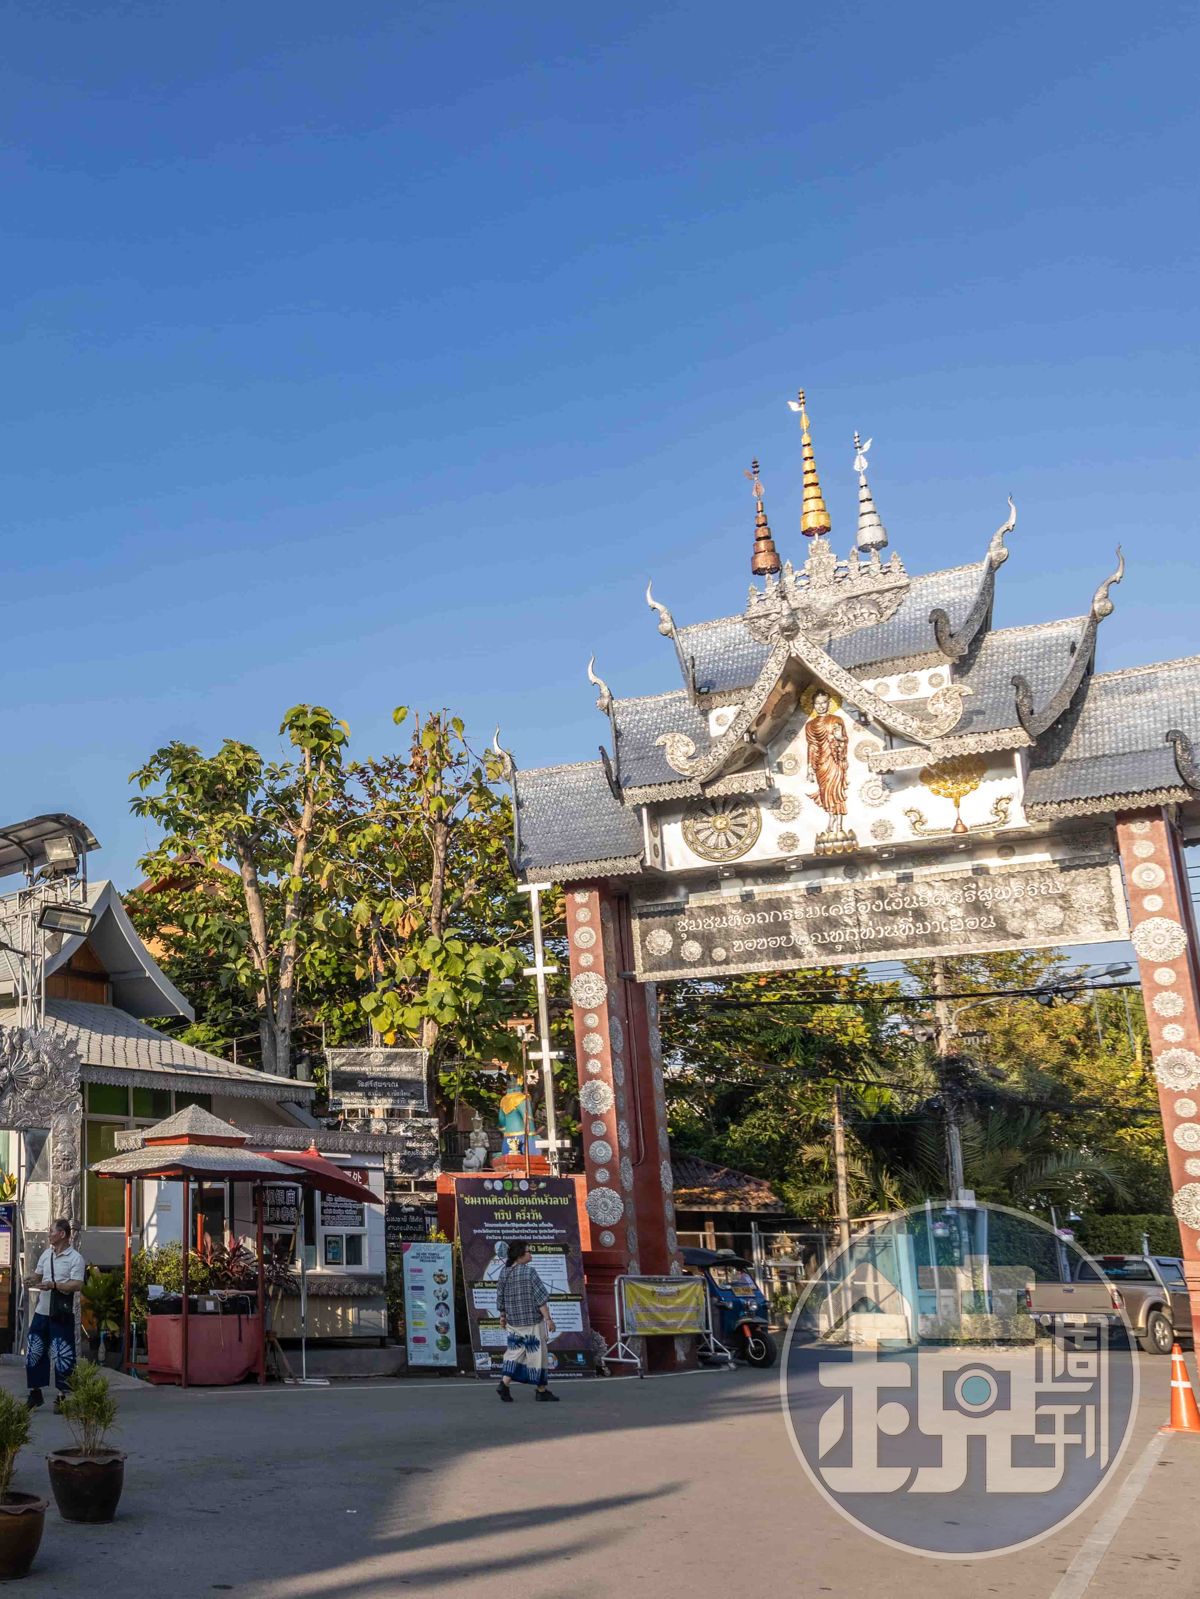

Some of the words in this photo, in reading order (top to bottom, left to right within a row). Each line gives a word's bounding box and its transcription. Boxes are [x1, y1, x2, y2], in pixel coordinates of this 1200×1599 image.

[732, 910, 997, 956] ขอขอบคุณทุกท่านที่มาเยือน
[493, 1209, 511, 1221] ทริป
[515, 1207, 543, 1221] ครึ่งวัน
